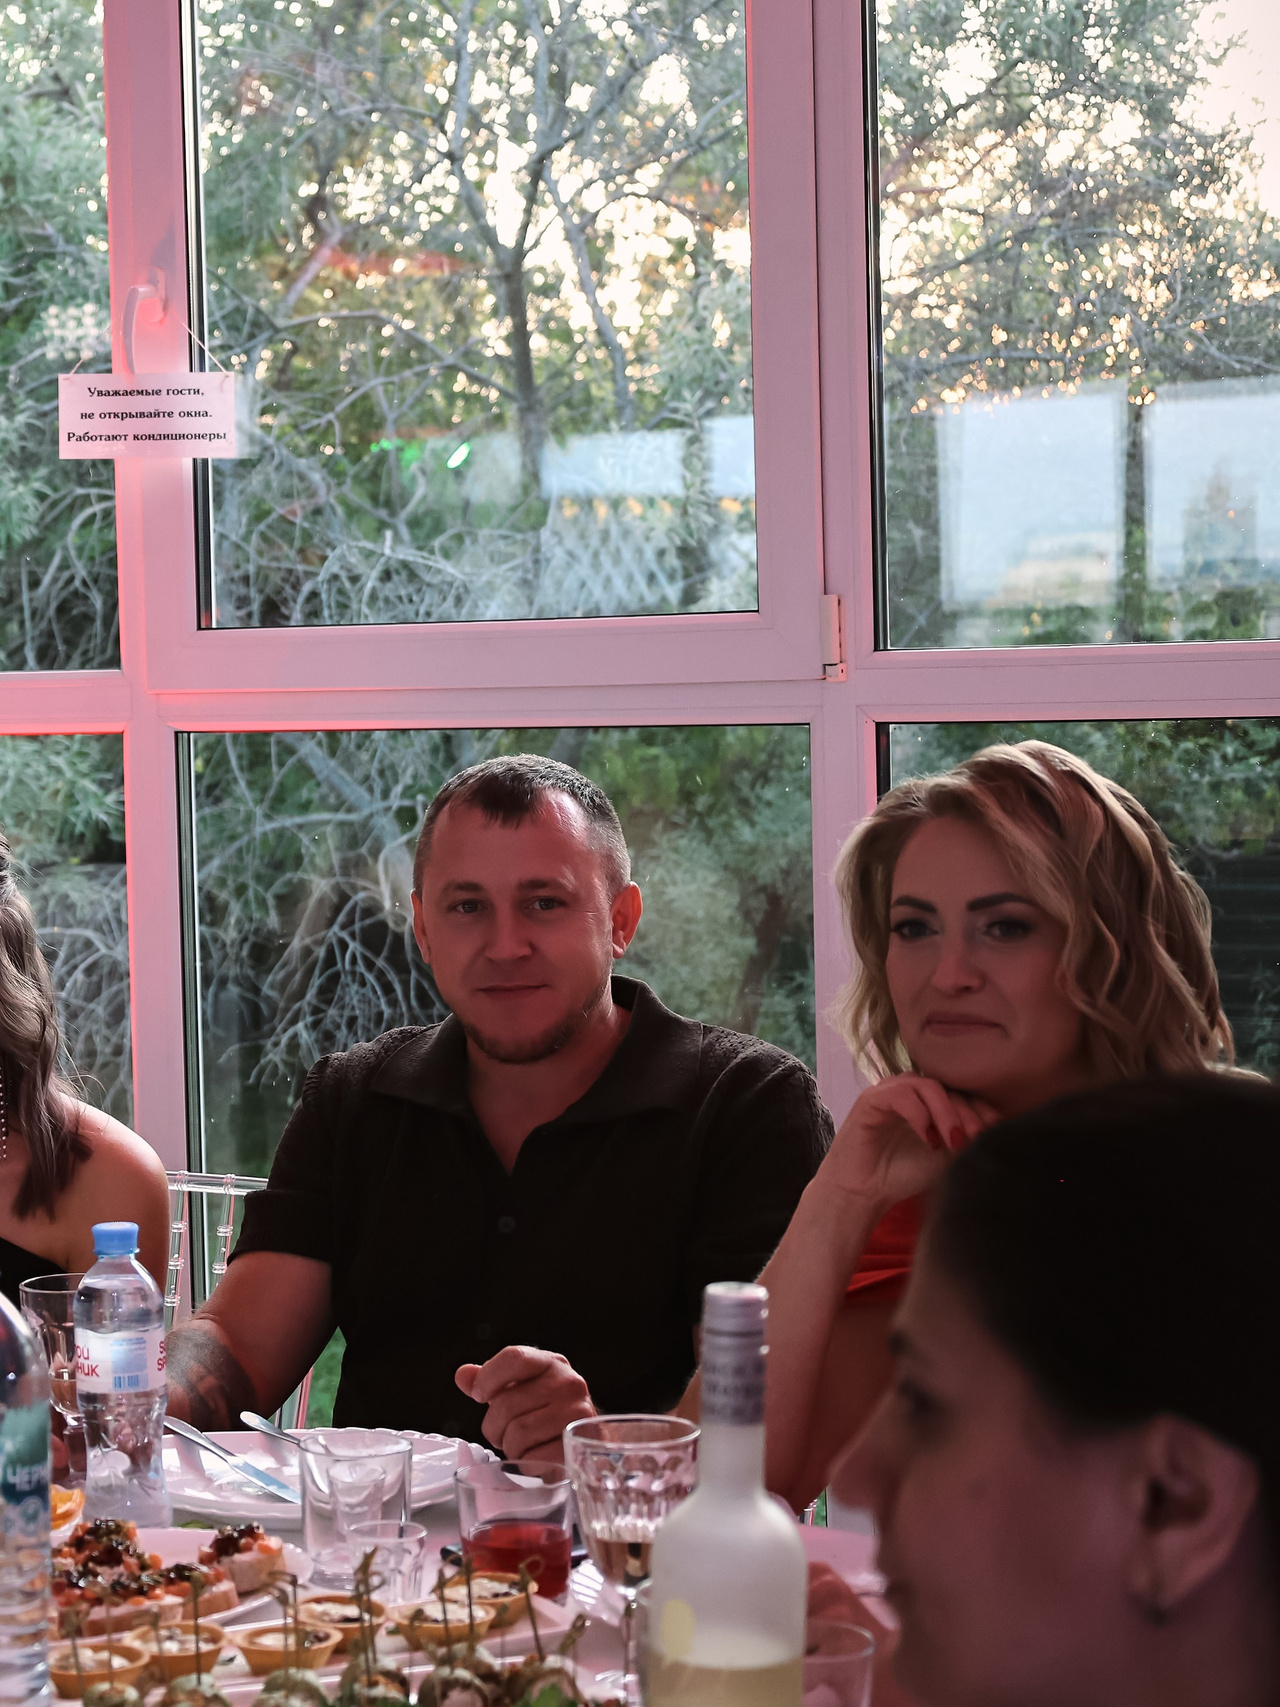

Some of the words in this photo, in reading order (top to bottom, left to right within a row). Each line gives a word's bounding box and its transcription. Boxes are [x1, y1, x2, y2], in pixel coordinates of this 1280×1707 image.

[87, 387, 162, 398] Уважаемые
[166, 387, 205, 397] гости,
[80, 410, 95, 420] не
[98, 408, 174, 421] открывайте
[178, 409, 213, 418] окна.
[67, 431, 129, 442] Работают
[132, 431, 227, 443] кондиционеры
